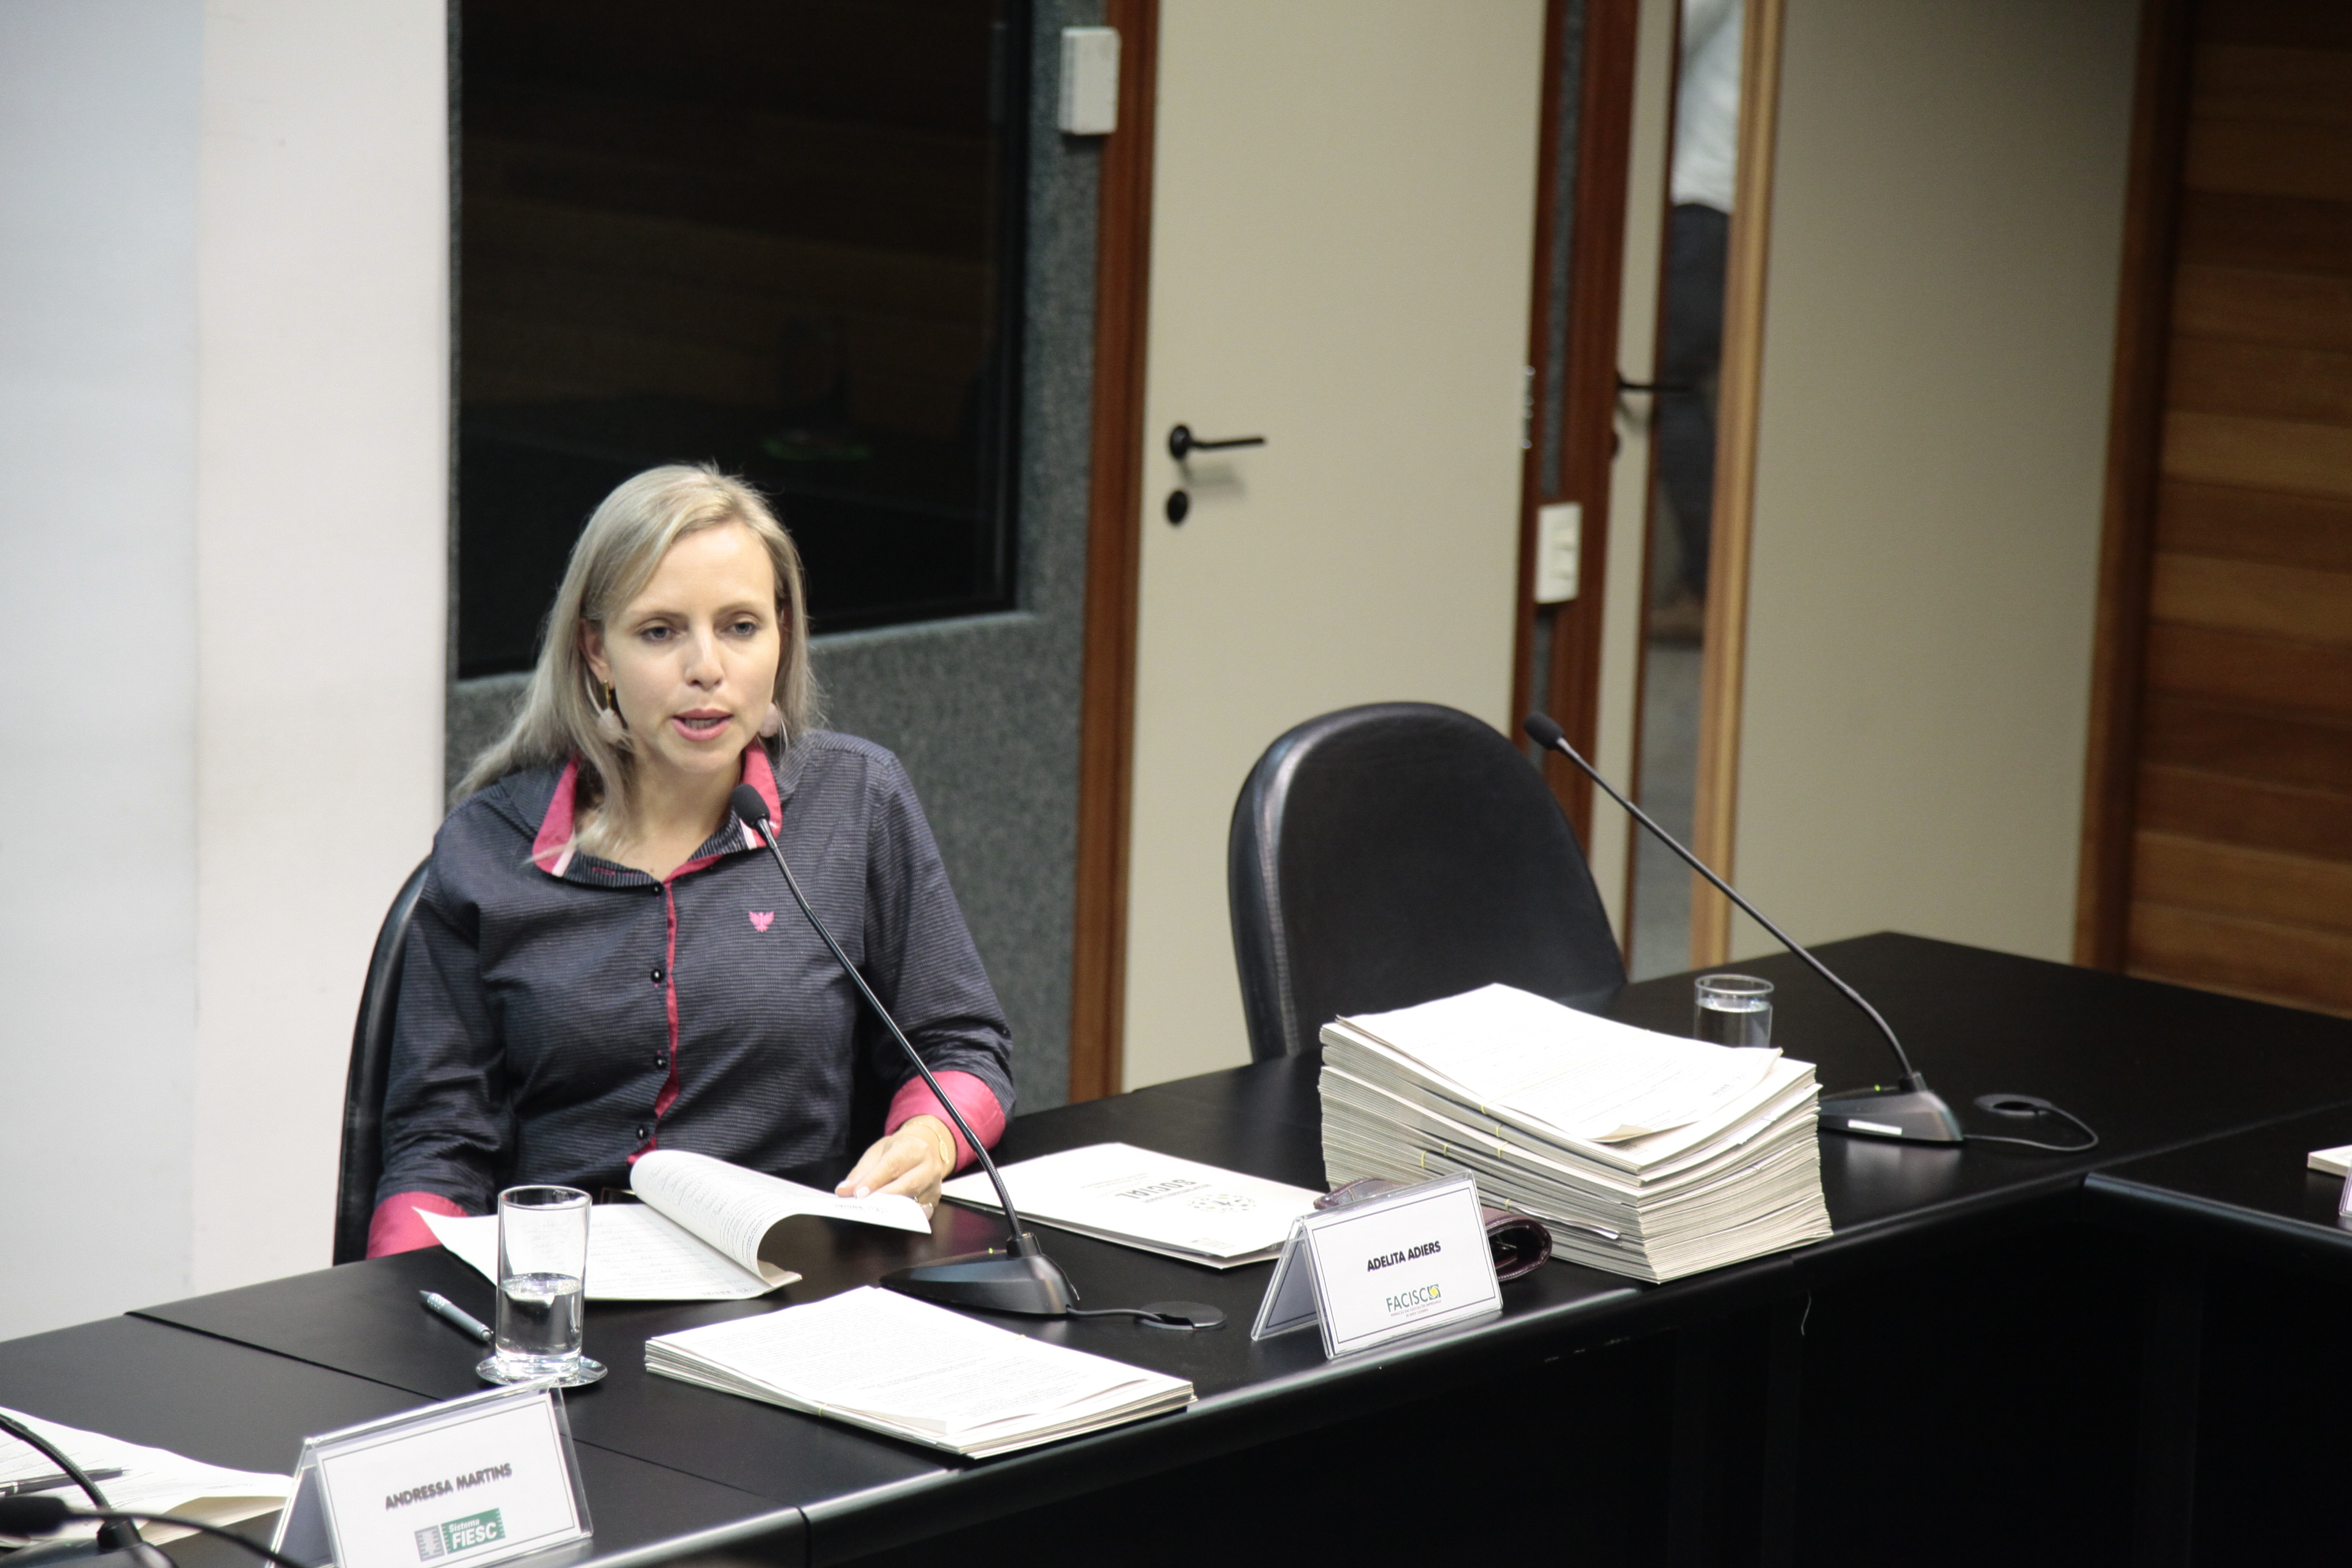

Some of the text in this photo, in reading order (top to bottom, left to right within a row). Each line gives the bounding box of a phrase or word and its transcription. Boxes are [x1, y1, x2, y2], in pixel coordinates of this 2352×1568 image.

[1114, 1178, 1197, 1200] SOCIAL
[1367, 1241, 1442, 1272] ADELITA ADIERS
[385, 1463, 512, 1510] ANDRESSA MARTINS
[448, 1518, 481, 1533] Sistema
[452, 1522, 497, 1550] FIESC
